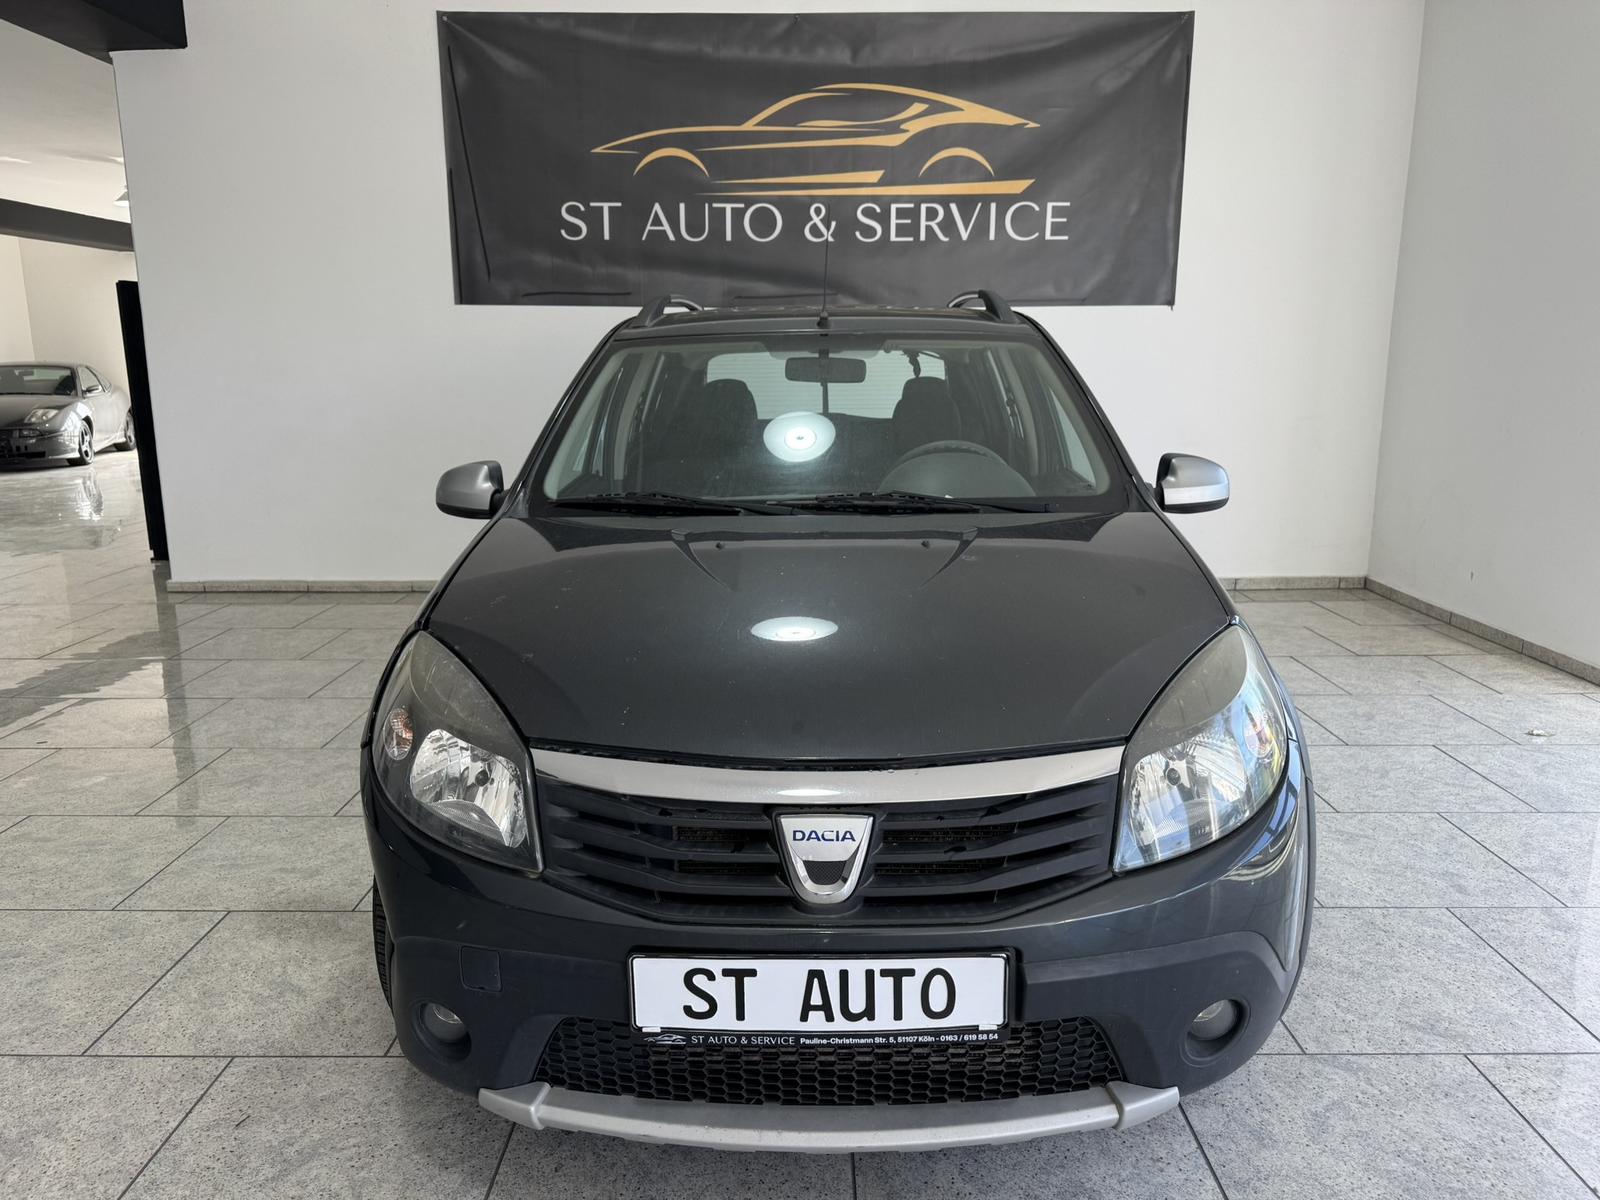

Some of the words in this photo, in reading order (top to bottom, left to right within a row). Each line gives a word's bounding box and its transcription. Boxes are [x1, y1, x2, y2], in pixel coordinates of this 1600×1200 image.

[560, 201, 622, 241] ST
[642, 201, 784, 242] AUTO
[803, 202, 837, 242] &
[855, 201, 1072, 242] SERVICE
[792, 829, 857, 842] DACIA
[682, 967, 758, 1022] ST
[799, 967, 957, 1023] AUTO
[691, 1035, 705, 1044] ST
[708, 1035, 738, 1045] AUTO
[740, 1036, 748, 1045] &
[751, 1036, 796, 1045] SERVICE
[800, 1036, 874, 1045] Pauline-Christmann
[874, 1036, 888, 1044] Str.
[889, 1036, 896, 1044] 5,
[897, 1036, 918, 1044] 51107
[918, 1034, 935, 1042] Köln
[940, 1034, 958, 1042] 0163
